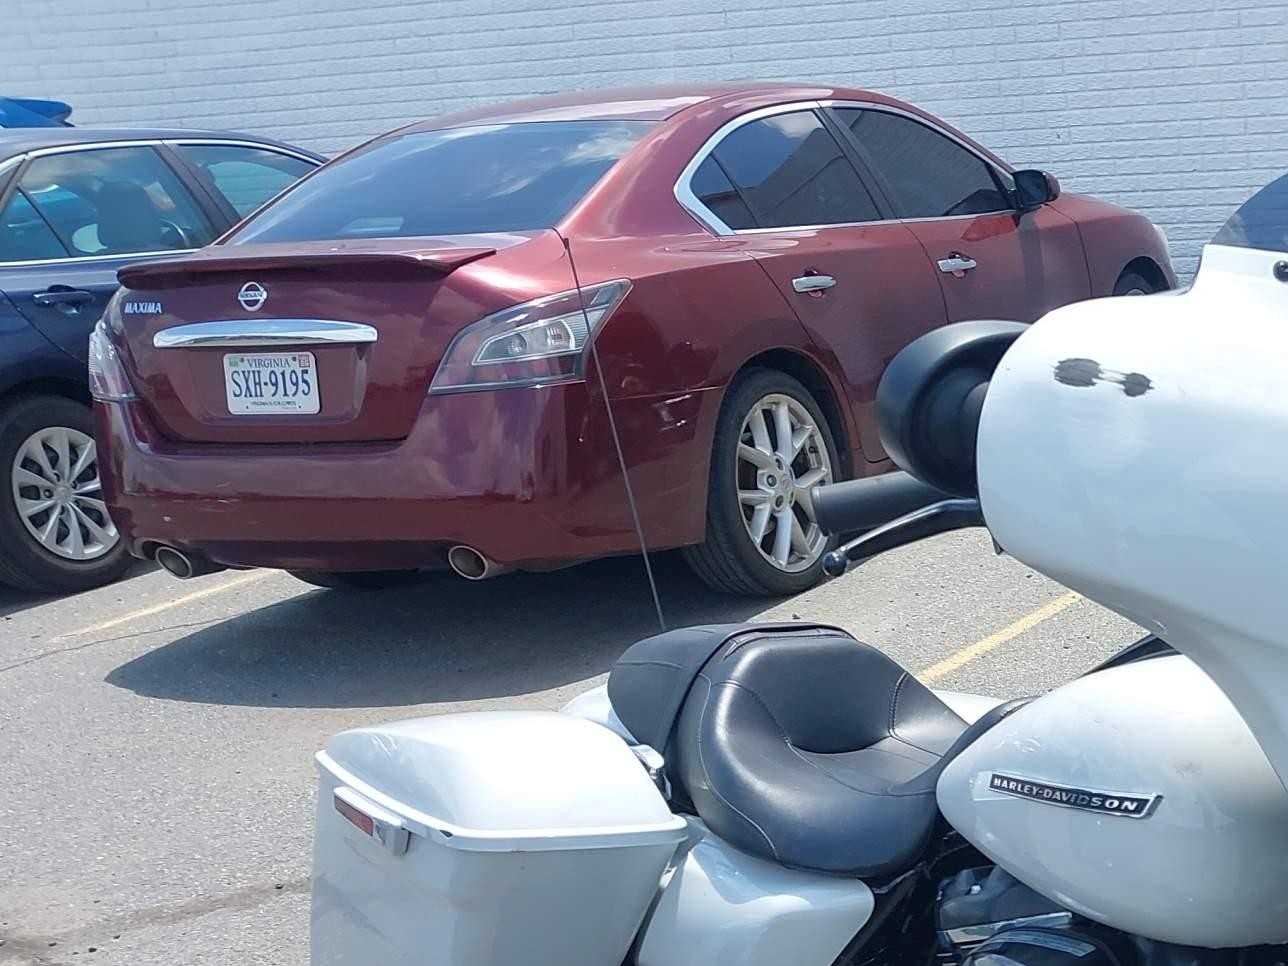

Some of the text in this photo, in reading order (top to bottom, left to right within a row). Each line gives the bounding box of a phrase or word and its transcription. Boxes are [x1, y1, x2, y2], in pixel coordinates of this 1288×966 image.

[124, 302, 163, 314] MAXIMA
[246, 358, 291, 369] VIRGINIA
[231, 369, 311, 398] SXH-9195
[993, 777, 1139, 812] HARLEY-DAVIDSON
